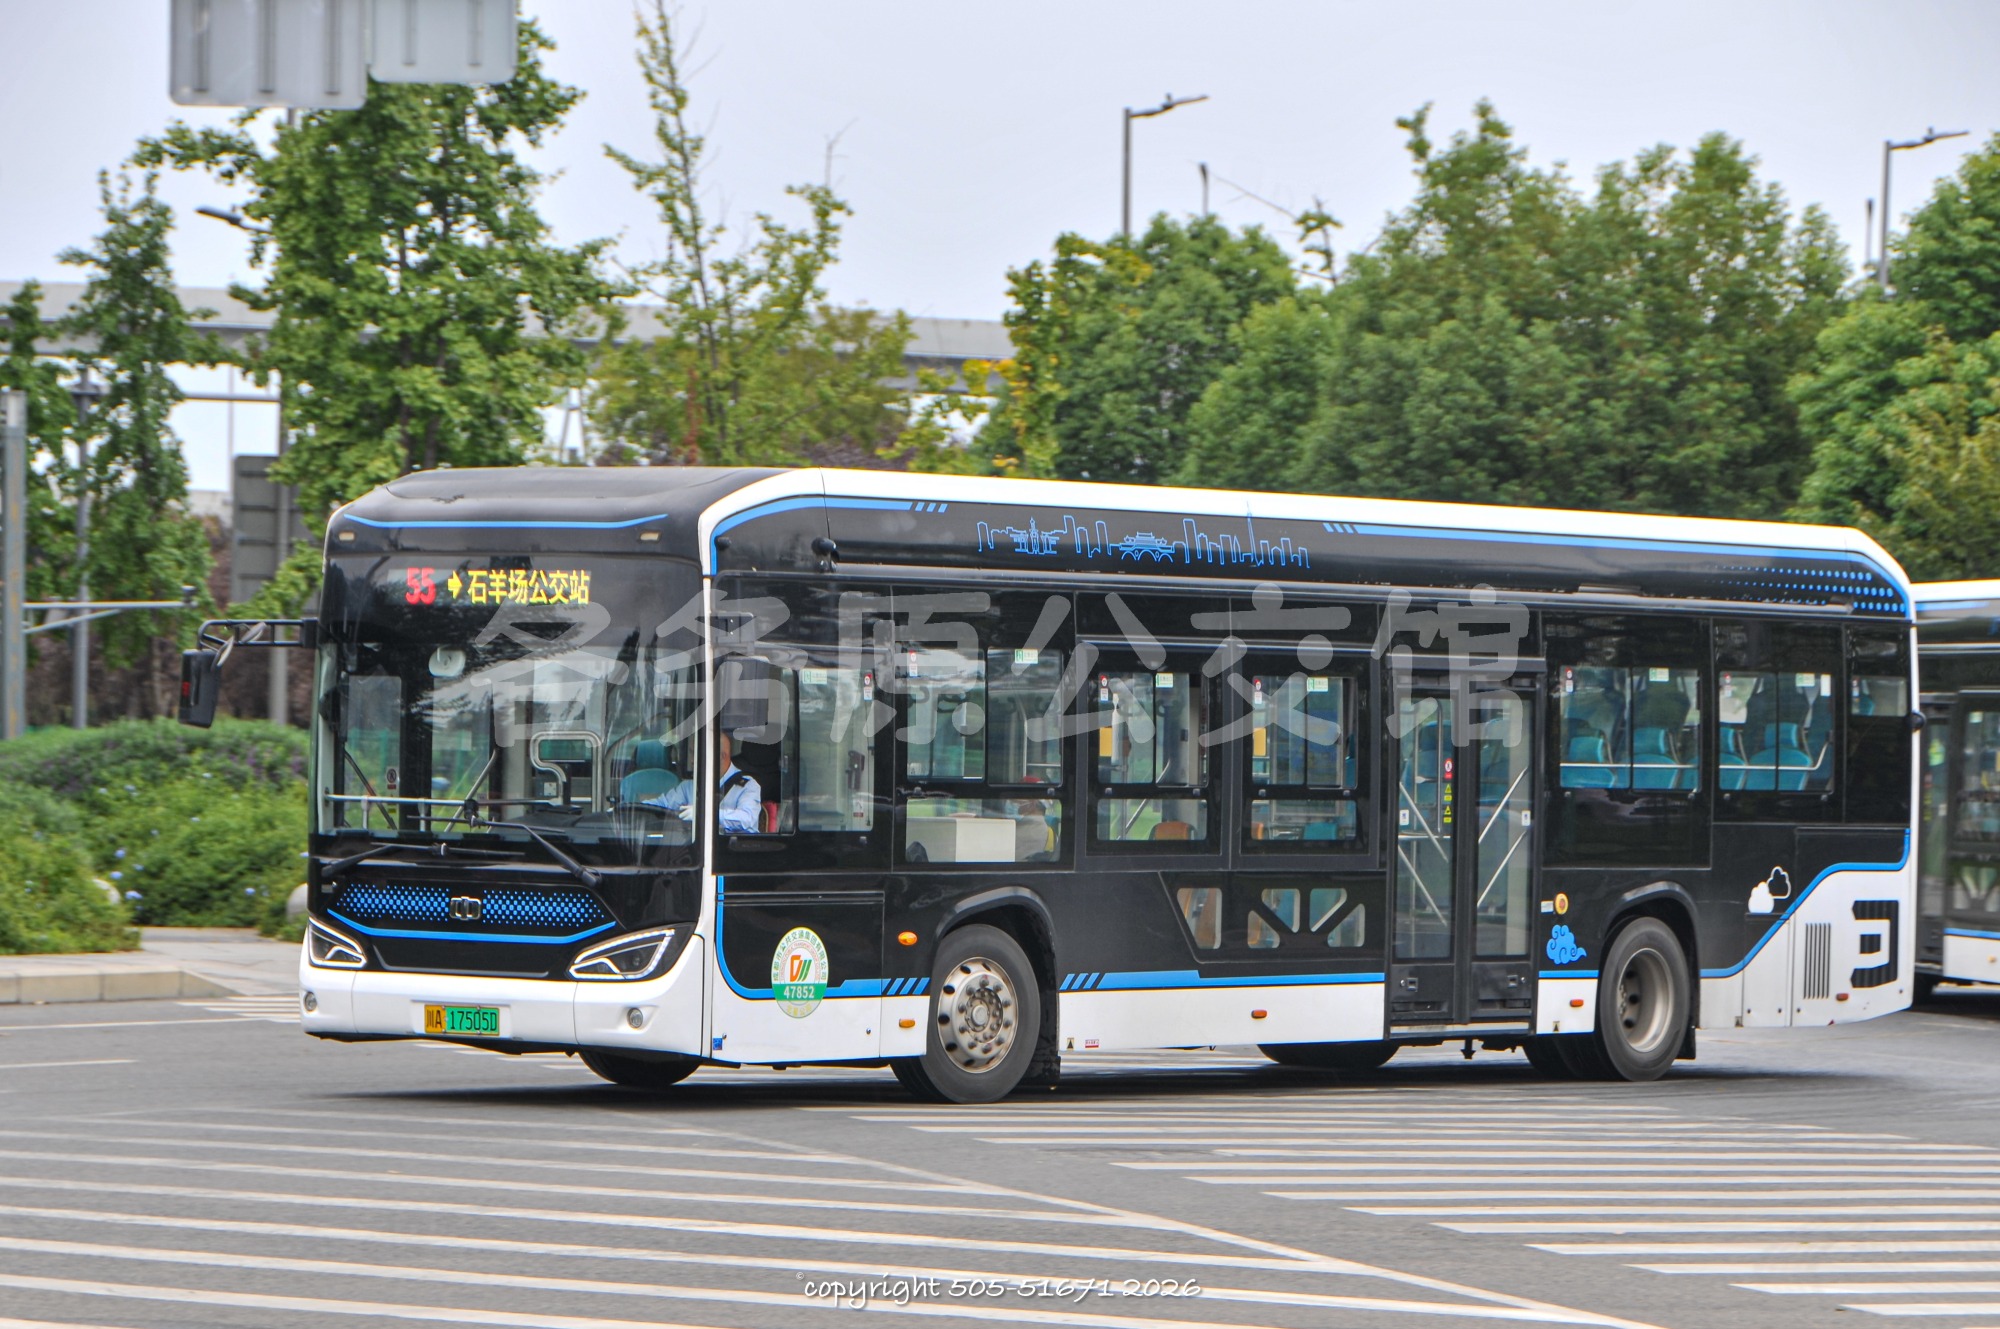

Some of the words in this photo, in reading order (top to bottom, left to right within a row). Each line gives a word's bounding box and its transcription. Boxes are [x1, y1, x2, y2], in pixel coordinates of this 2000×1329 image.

[406, 568, 436, 605] 55
[467, 569, 591, 605] 石羊场公交站
[783, 986, 815, 999] 47852
